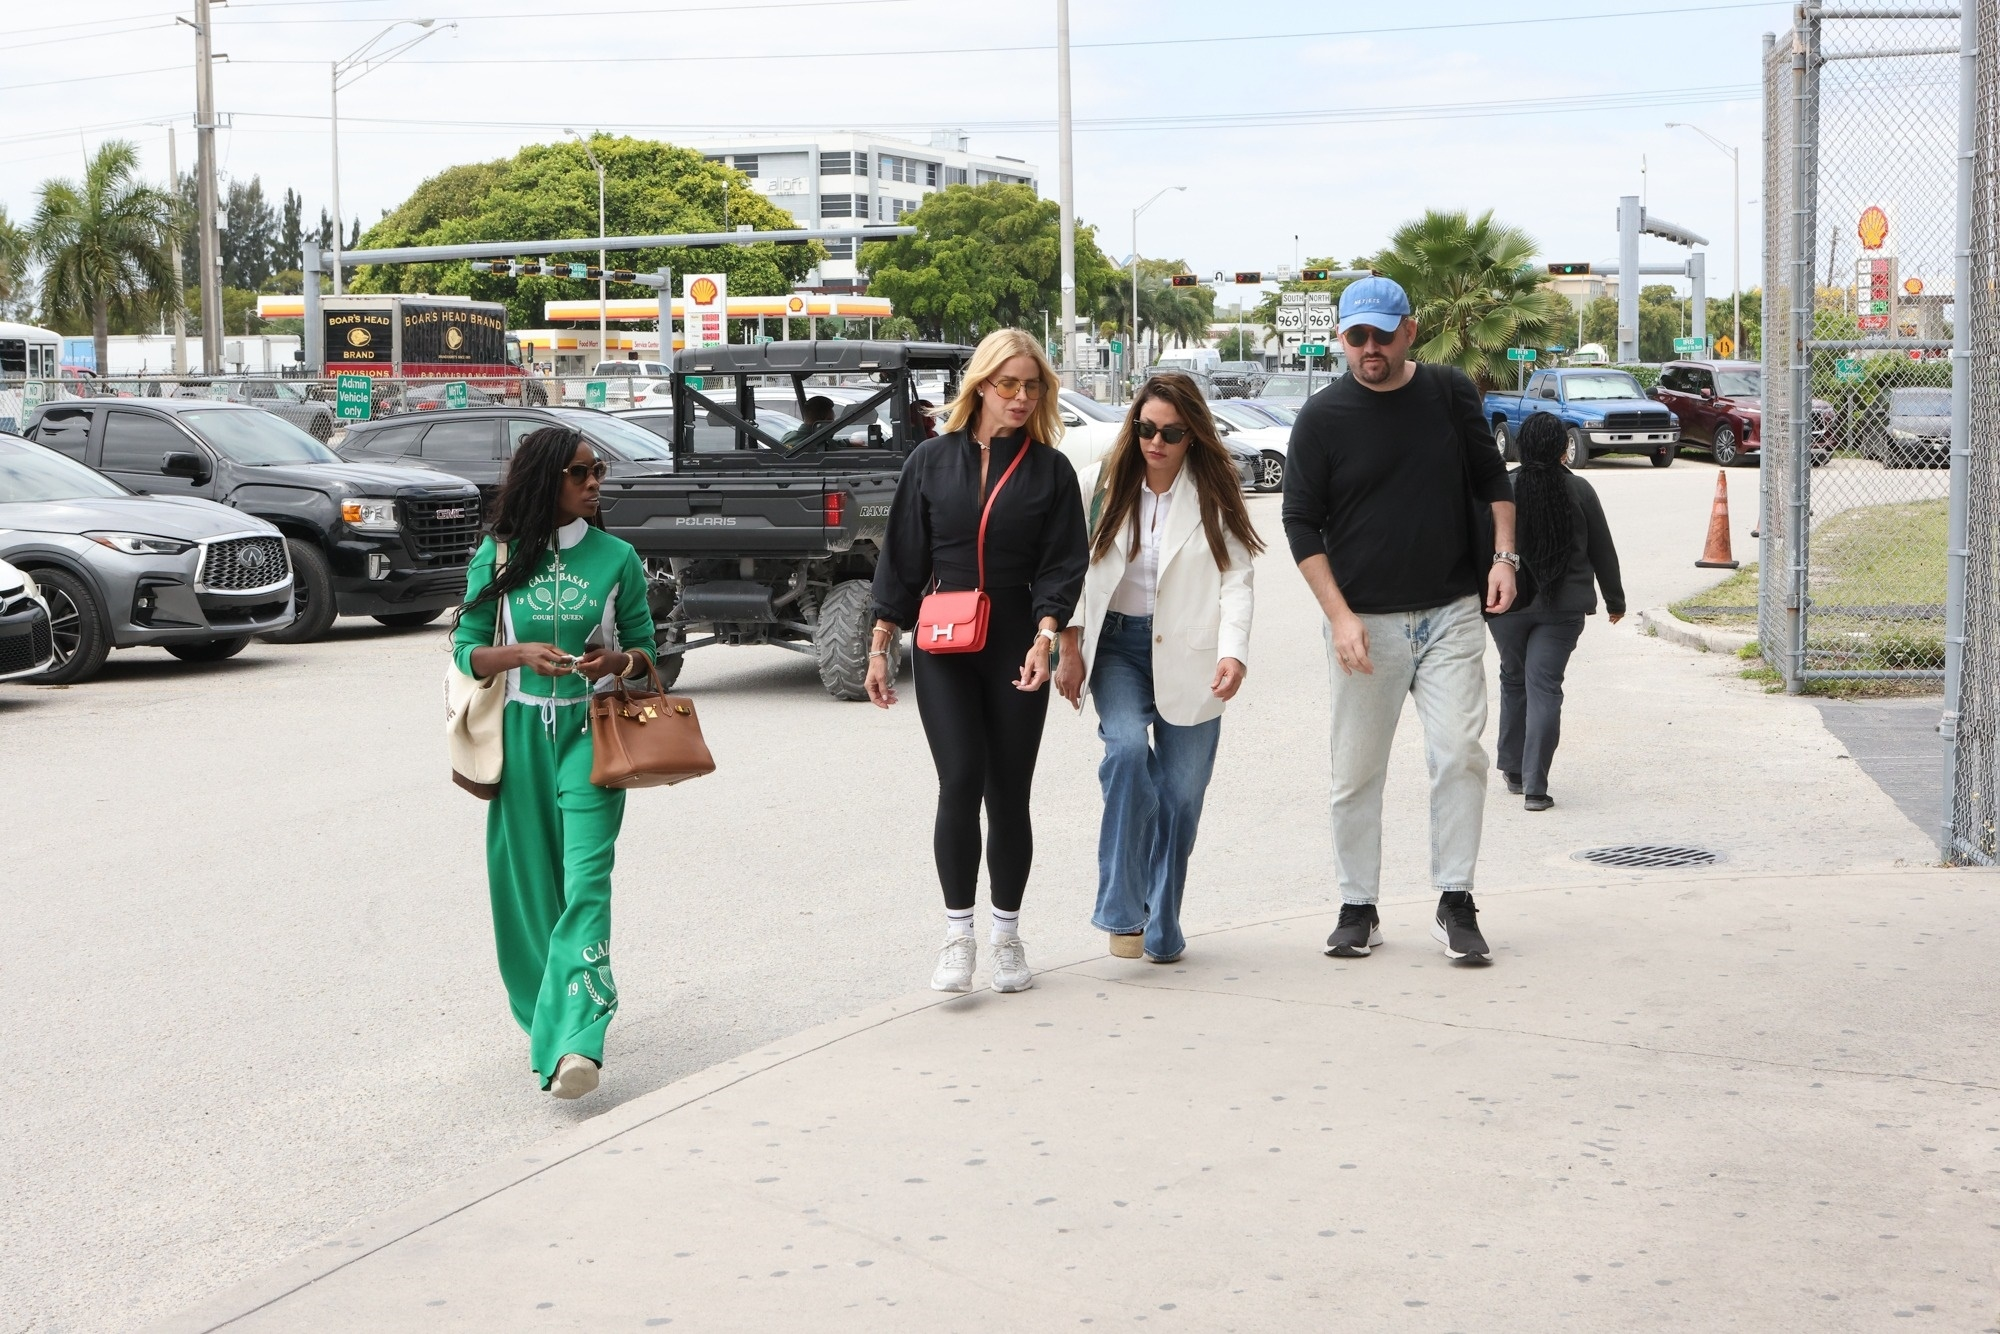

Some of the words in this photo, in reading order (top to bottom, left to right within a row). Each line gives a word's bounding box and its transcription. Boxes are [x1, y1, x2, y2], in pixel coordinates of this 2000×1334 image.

[1283, 294, 1304, 303] SOUTH
[1309, 294, 1330, 302] NORTH
[329, 313, 361, 326] BOAR'S
[364, 315, 390, 326] HEAD
[405, 311, 438, 327] BOAR'S
[442, 311, 467, 322] HEAD
[470, 315, 502, 330] BRAND
[1278, 315, 1299, 326] 969
[1309, 315, 1330, 326] 969
[343, 351, 375, 359] BRAND
[341, 377, 367, 389] Admin
[339, 390, 369, 403] Vehicle
[344, 405, 362, 418] only
[436, 507, 465, 519] GMC
[860, 505, 891, 517] RANG
[675, 517, 737, 526] POLARIS
[515, 597, 525, 605] 19
[589, 599, 598, 607] 91
[560, 613, 584, 621] QUEEN
[931, 623, 955, 643] H
[568, 981, 579, 997] 19
